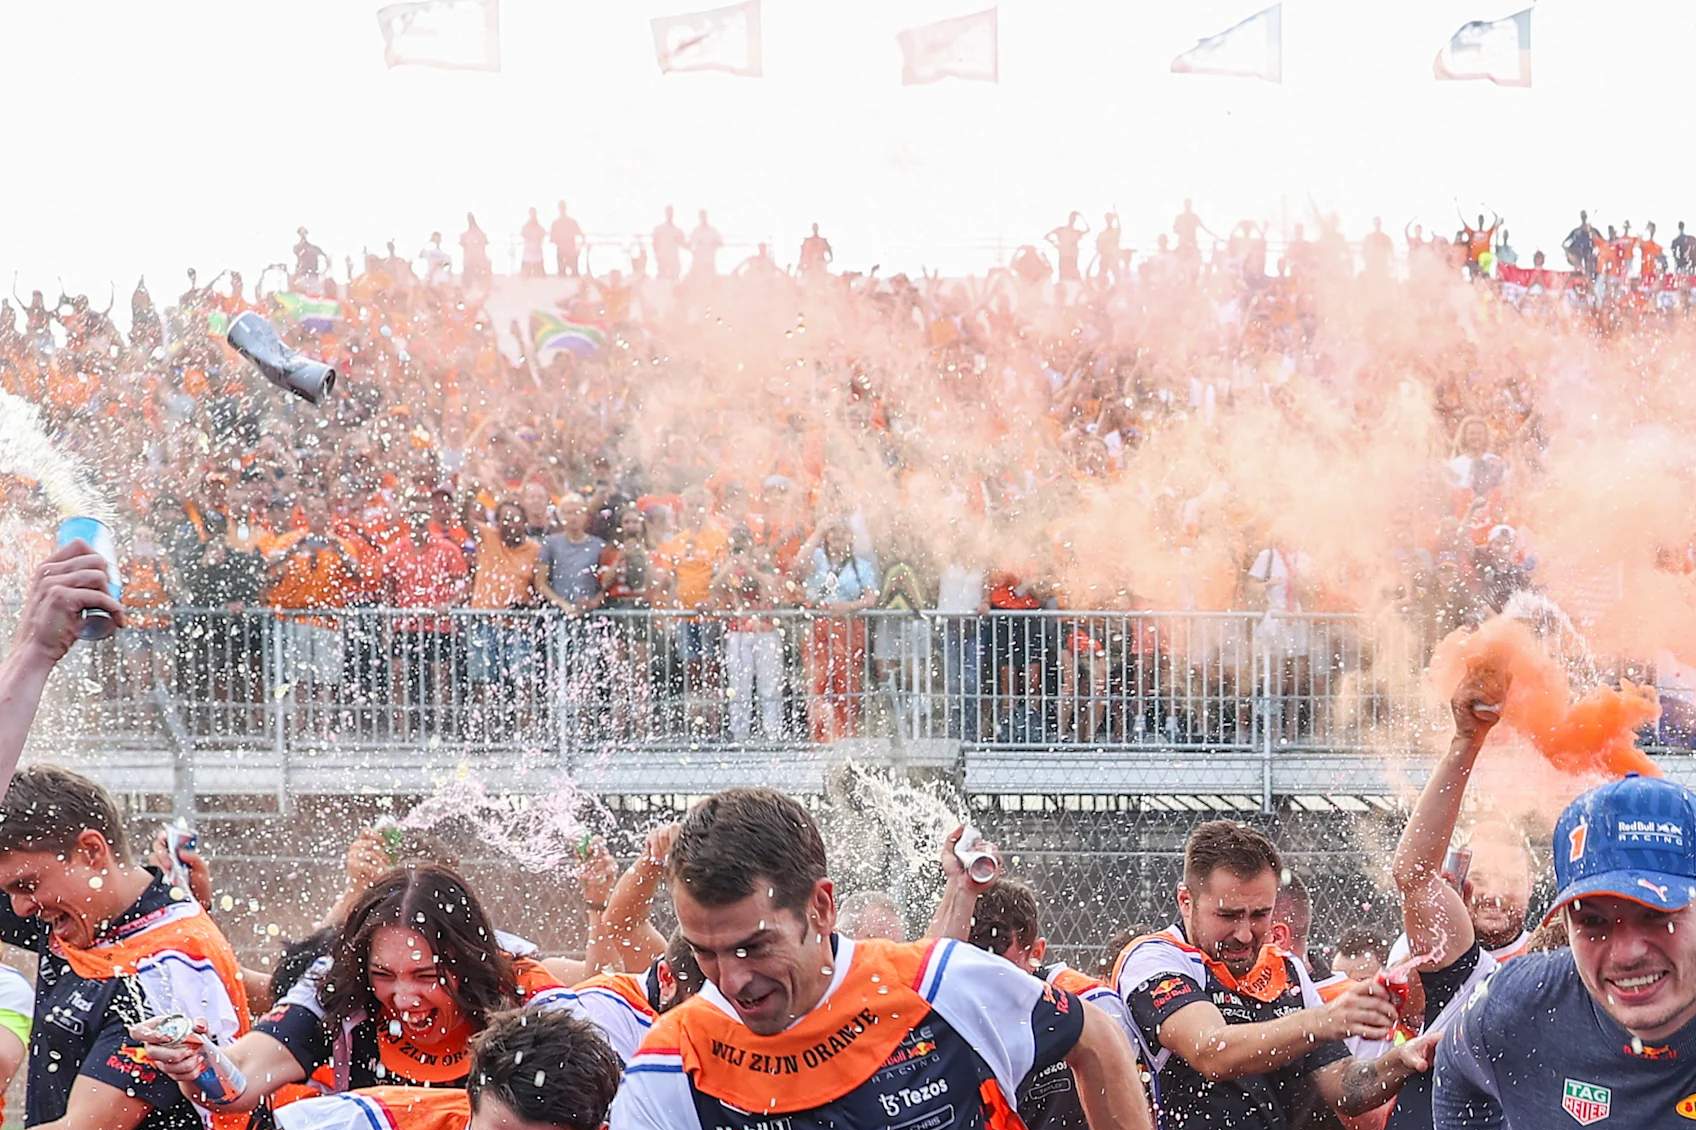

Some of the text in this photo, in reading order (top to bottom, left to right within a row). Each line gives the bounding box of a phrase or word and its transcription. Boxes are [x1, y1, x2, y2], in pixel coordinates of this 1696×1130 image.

[1618, 820, 1655, 833] Red Bull
[1569, 822, 1588, 863] 1
[1618, 834, 1684, 847] RACING
[711, 1038, 747, 1066] WIJ
[751, 1053, 799, 1076] ZIJN
[804, 1006, 880, 1069] ORANJE
[898, 1077, 949, 1108] Tezos
[1568, 1082, 1607, 1103] TAG
[1564, 1097, 1608, 1124] HEUER
